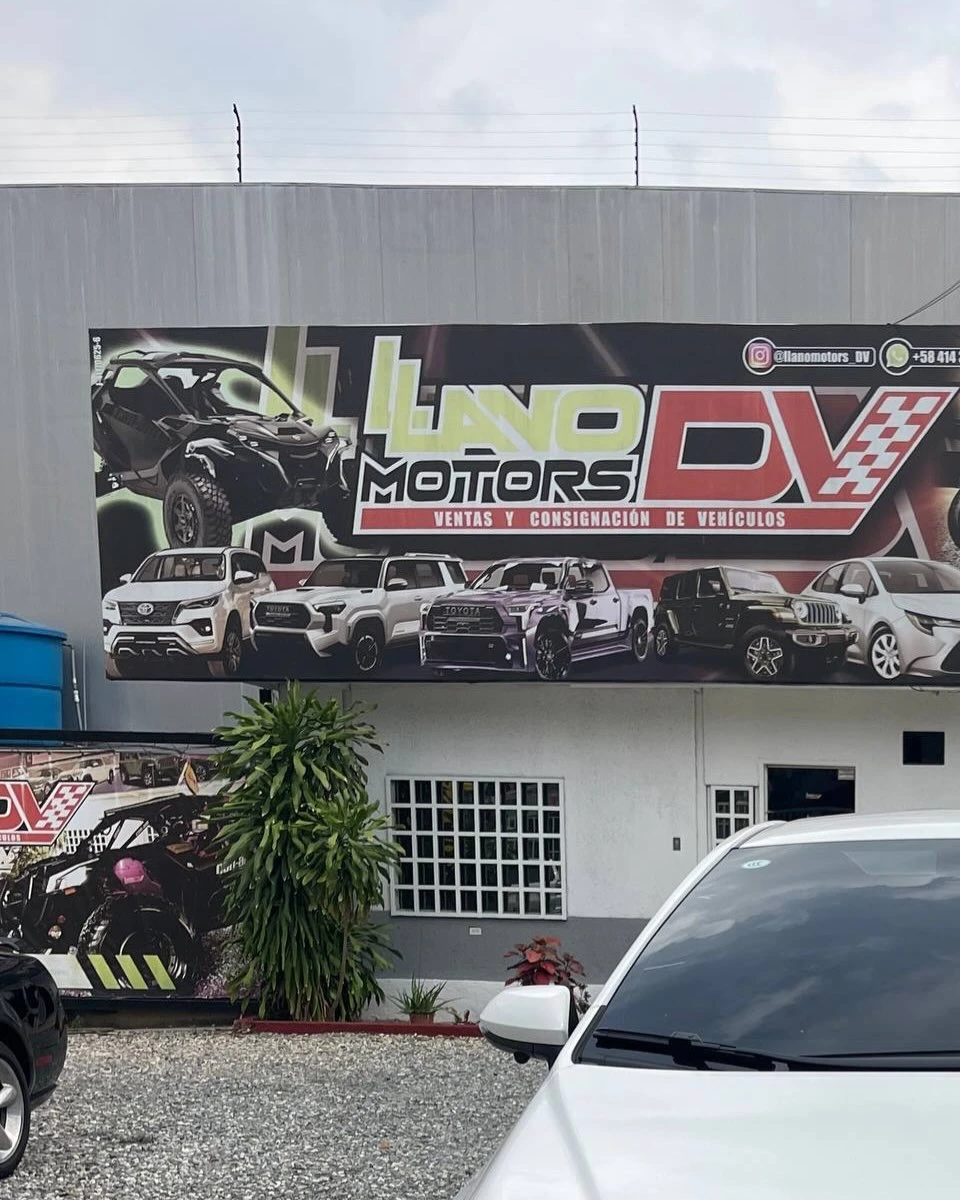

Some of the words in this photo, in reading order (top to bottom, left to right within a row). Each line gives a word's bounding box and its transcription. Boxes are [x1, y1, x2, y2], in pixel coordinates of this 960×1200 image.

[773, 350, 870, 365] @llanomotors_DV
[912, 350, 935, 364] +58
[937, 350, 956, 364] 414
[364, 336, 646, 457] LLANO
[642, 385, 960, 503] DV
[358, 456, 637, 503] MOTORS
[433, 510, 493, 527] VENTAS
[504, 510, 514, 527] Y
[529, 508, 650, 527] CONSIGNACIÓN
[666, 510, 685, 527] DE
[697, 508, 786, 527] VEHÍCULOS
[444, 606, 481, 617] TOYOTA
